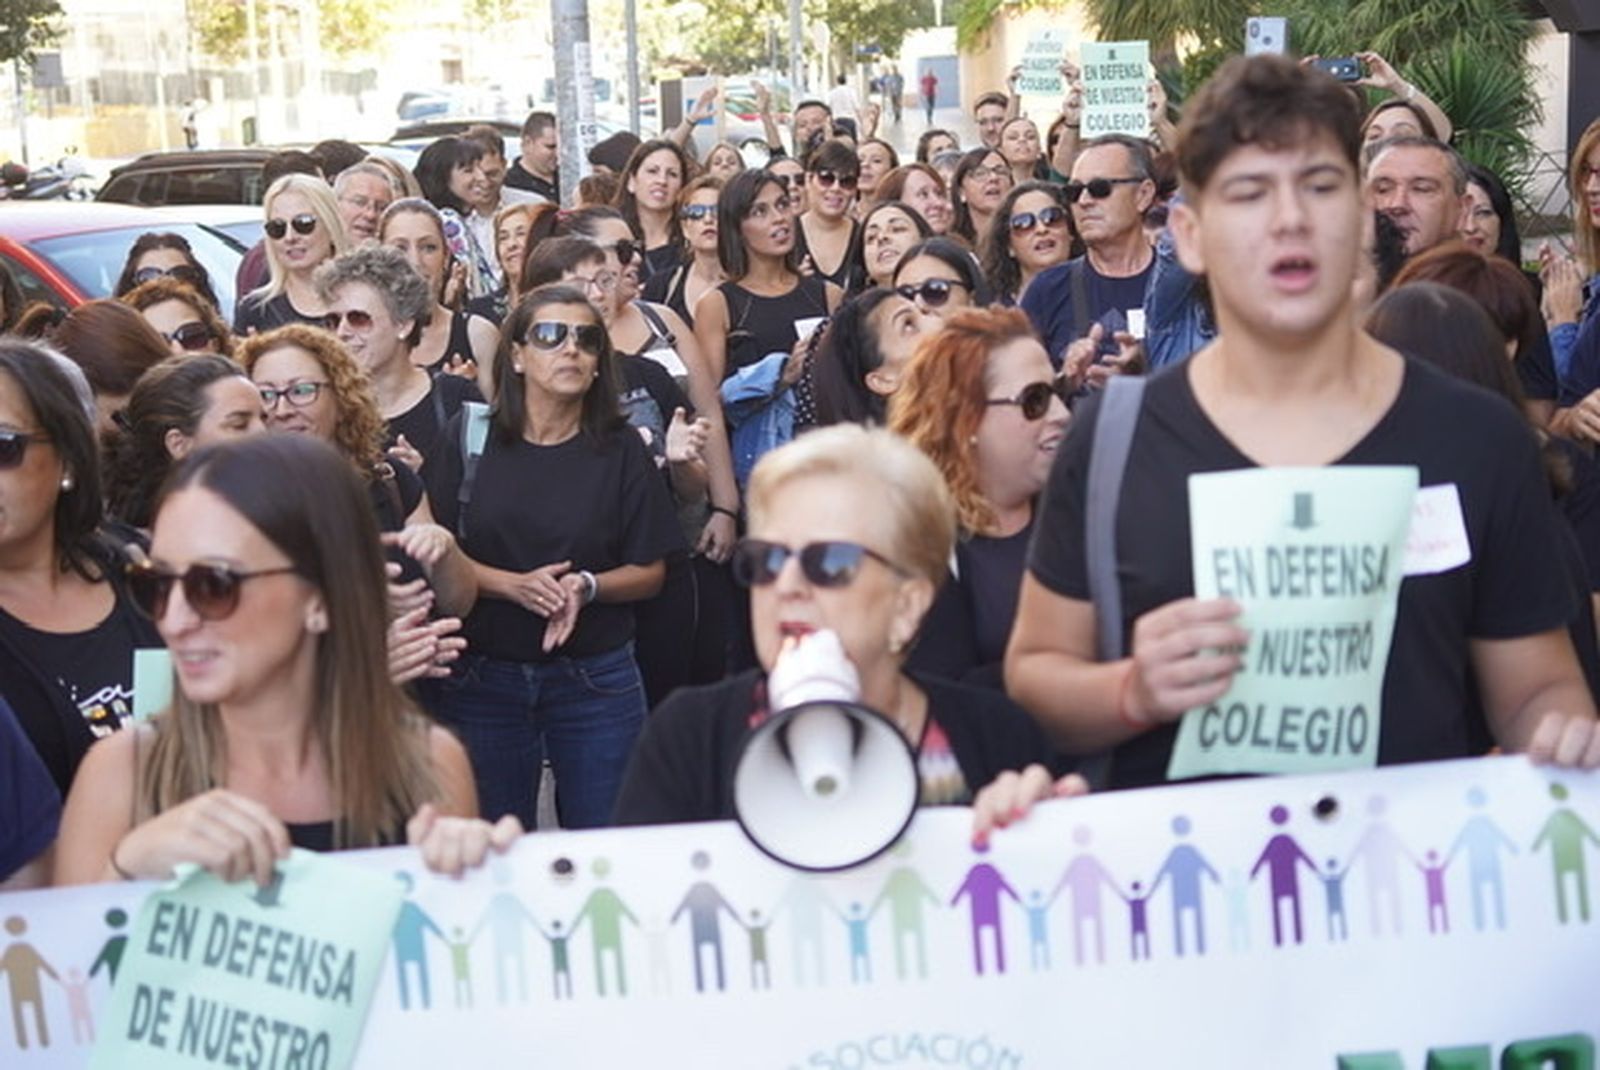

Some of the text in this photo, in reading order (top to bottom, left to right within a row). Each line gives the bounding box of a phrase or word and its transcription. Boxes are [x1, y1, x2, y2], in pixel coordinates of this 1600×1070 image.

[1084, 63, 1144, 80] EN DEFENSA
[1086, 113, 1146, 131] COLEGIO
[1213, 546, 1389, 598] EN DEFENSA
[1257, 621, 1374, 677] NUESTRO
[1199, 702, 1369, 755] COLEGIO
[146, 902, 355, 1006] EN DEFENSA
[127, 984, 330, 1070] DE NUESTRO
[788, 1033, 1024, 1070] SOCIACIÓN
